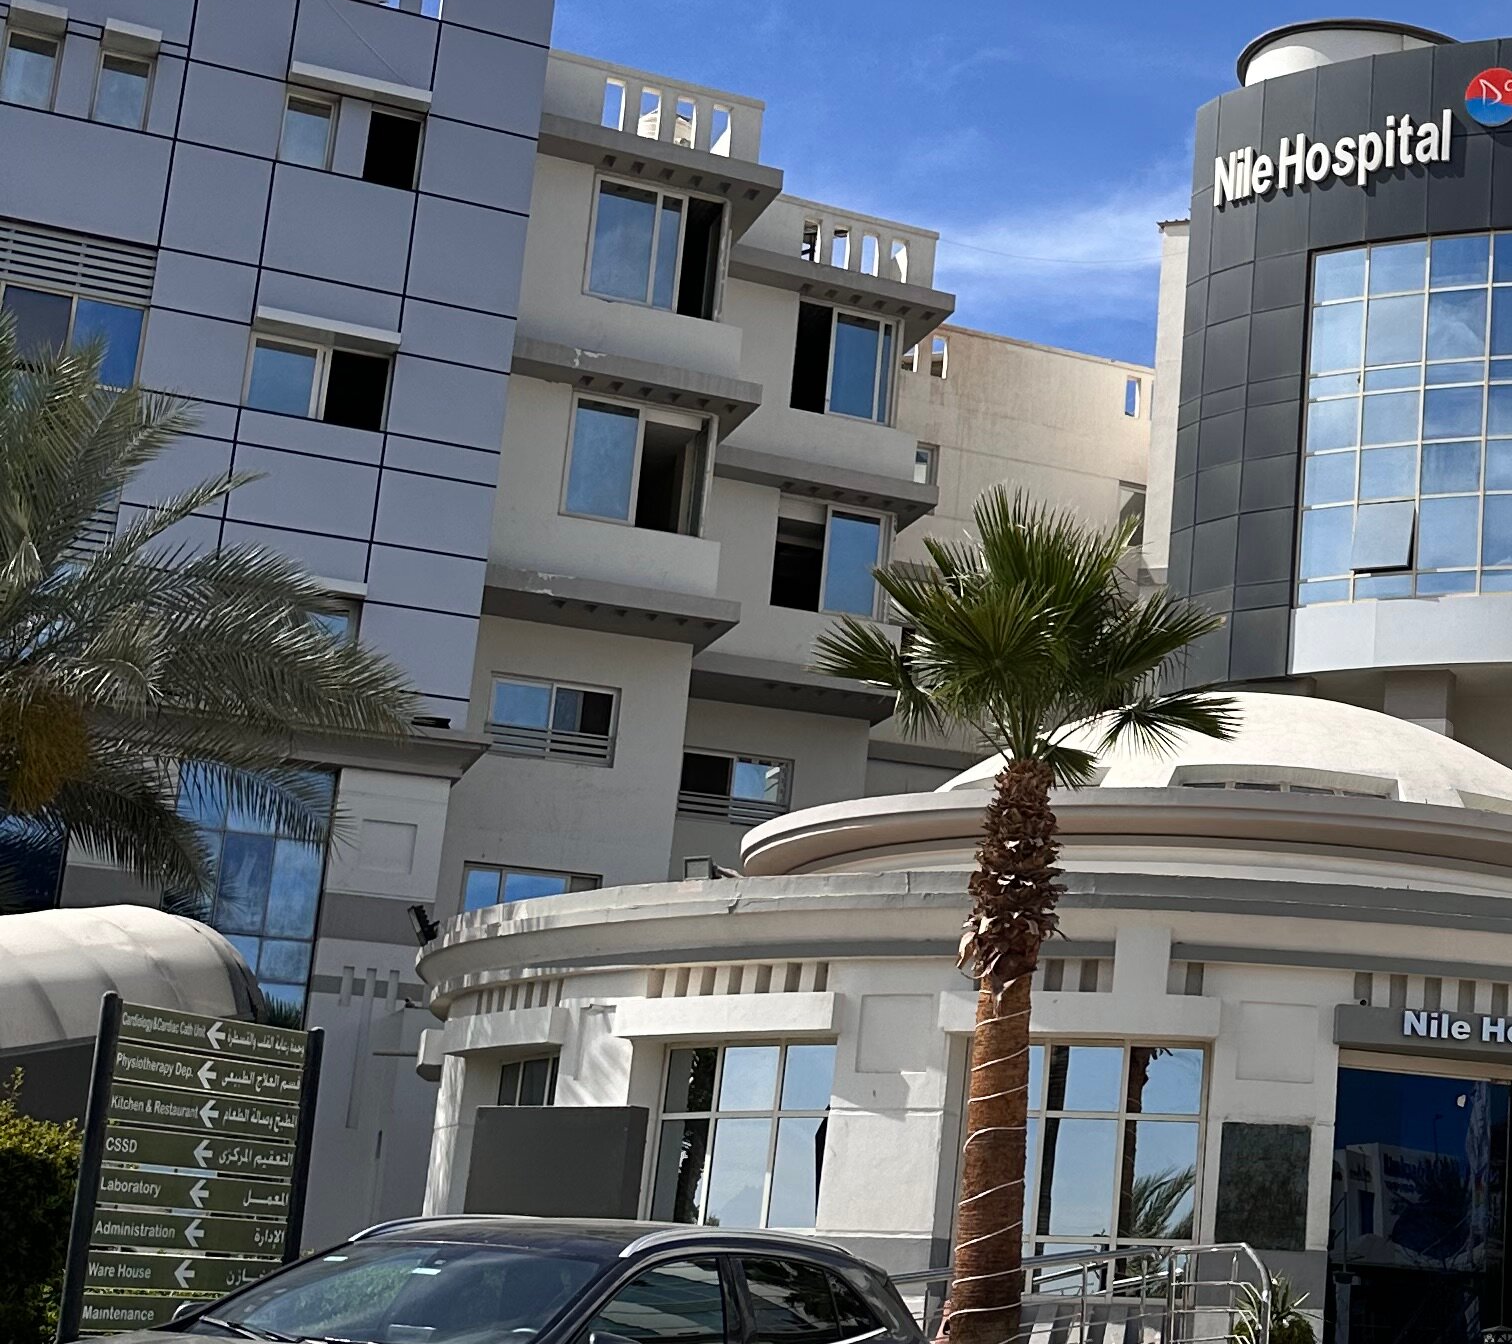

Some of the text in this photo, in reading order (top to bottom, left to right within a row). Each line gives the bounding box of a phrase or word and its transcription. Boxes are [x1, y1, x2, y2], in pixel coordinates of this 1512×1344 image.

[1213, 109, 1452, 207] Nile Hospital
[1403, 1010, 1471, 1040] Nile
[116, 1052, 194, 1079] Physiotherapy Dep.
[255, 1073, 280, 1092] العلاج
[280, 1076, 301, 1092] قسم
[111, 1095, 199, 1118] Kitchen & Restaurant
[222, 1107, 250, 1126] الطعام
[105, 1137, 138, 1153] CSSD
[253, 1150, 294, 1169] التعقيم
[100, 1176, 161, 1198] Laboratory
[94, 1220, 176, 1238] Administration
[254, 1227, 285, 1249] الإدارة
[88, 1262, 152, 1279] Ware House
[82, 1305, 155, 1321] Maintenance
